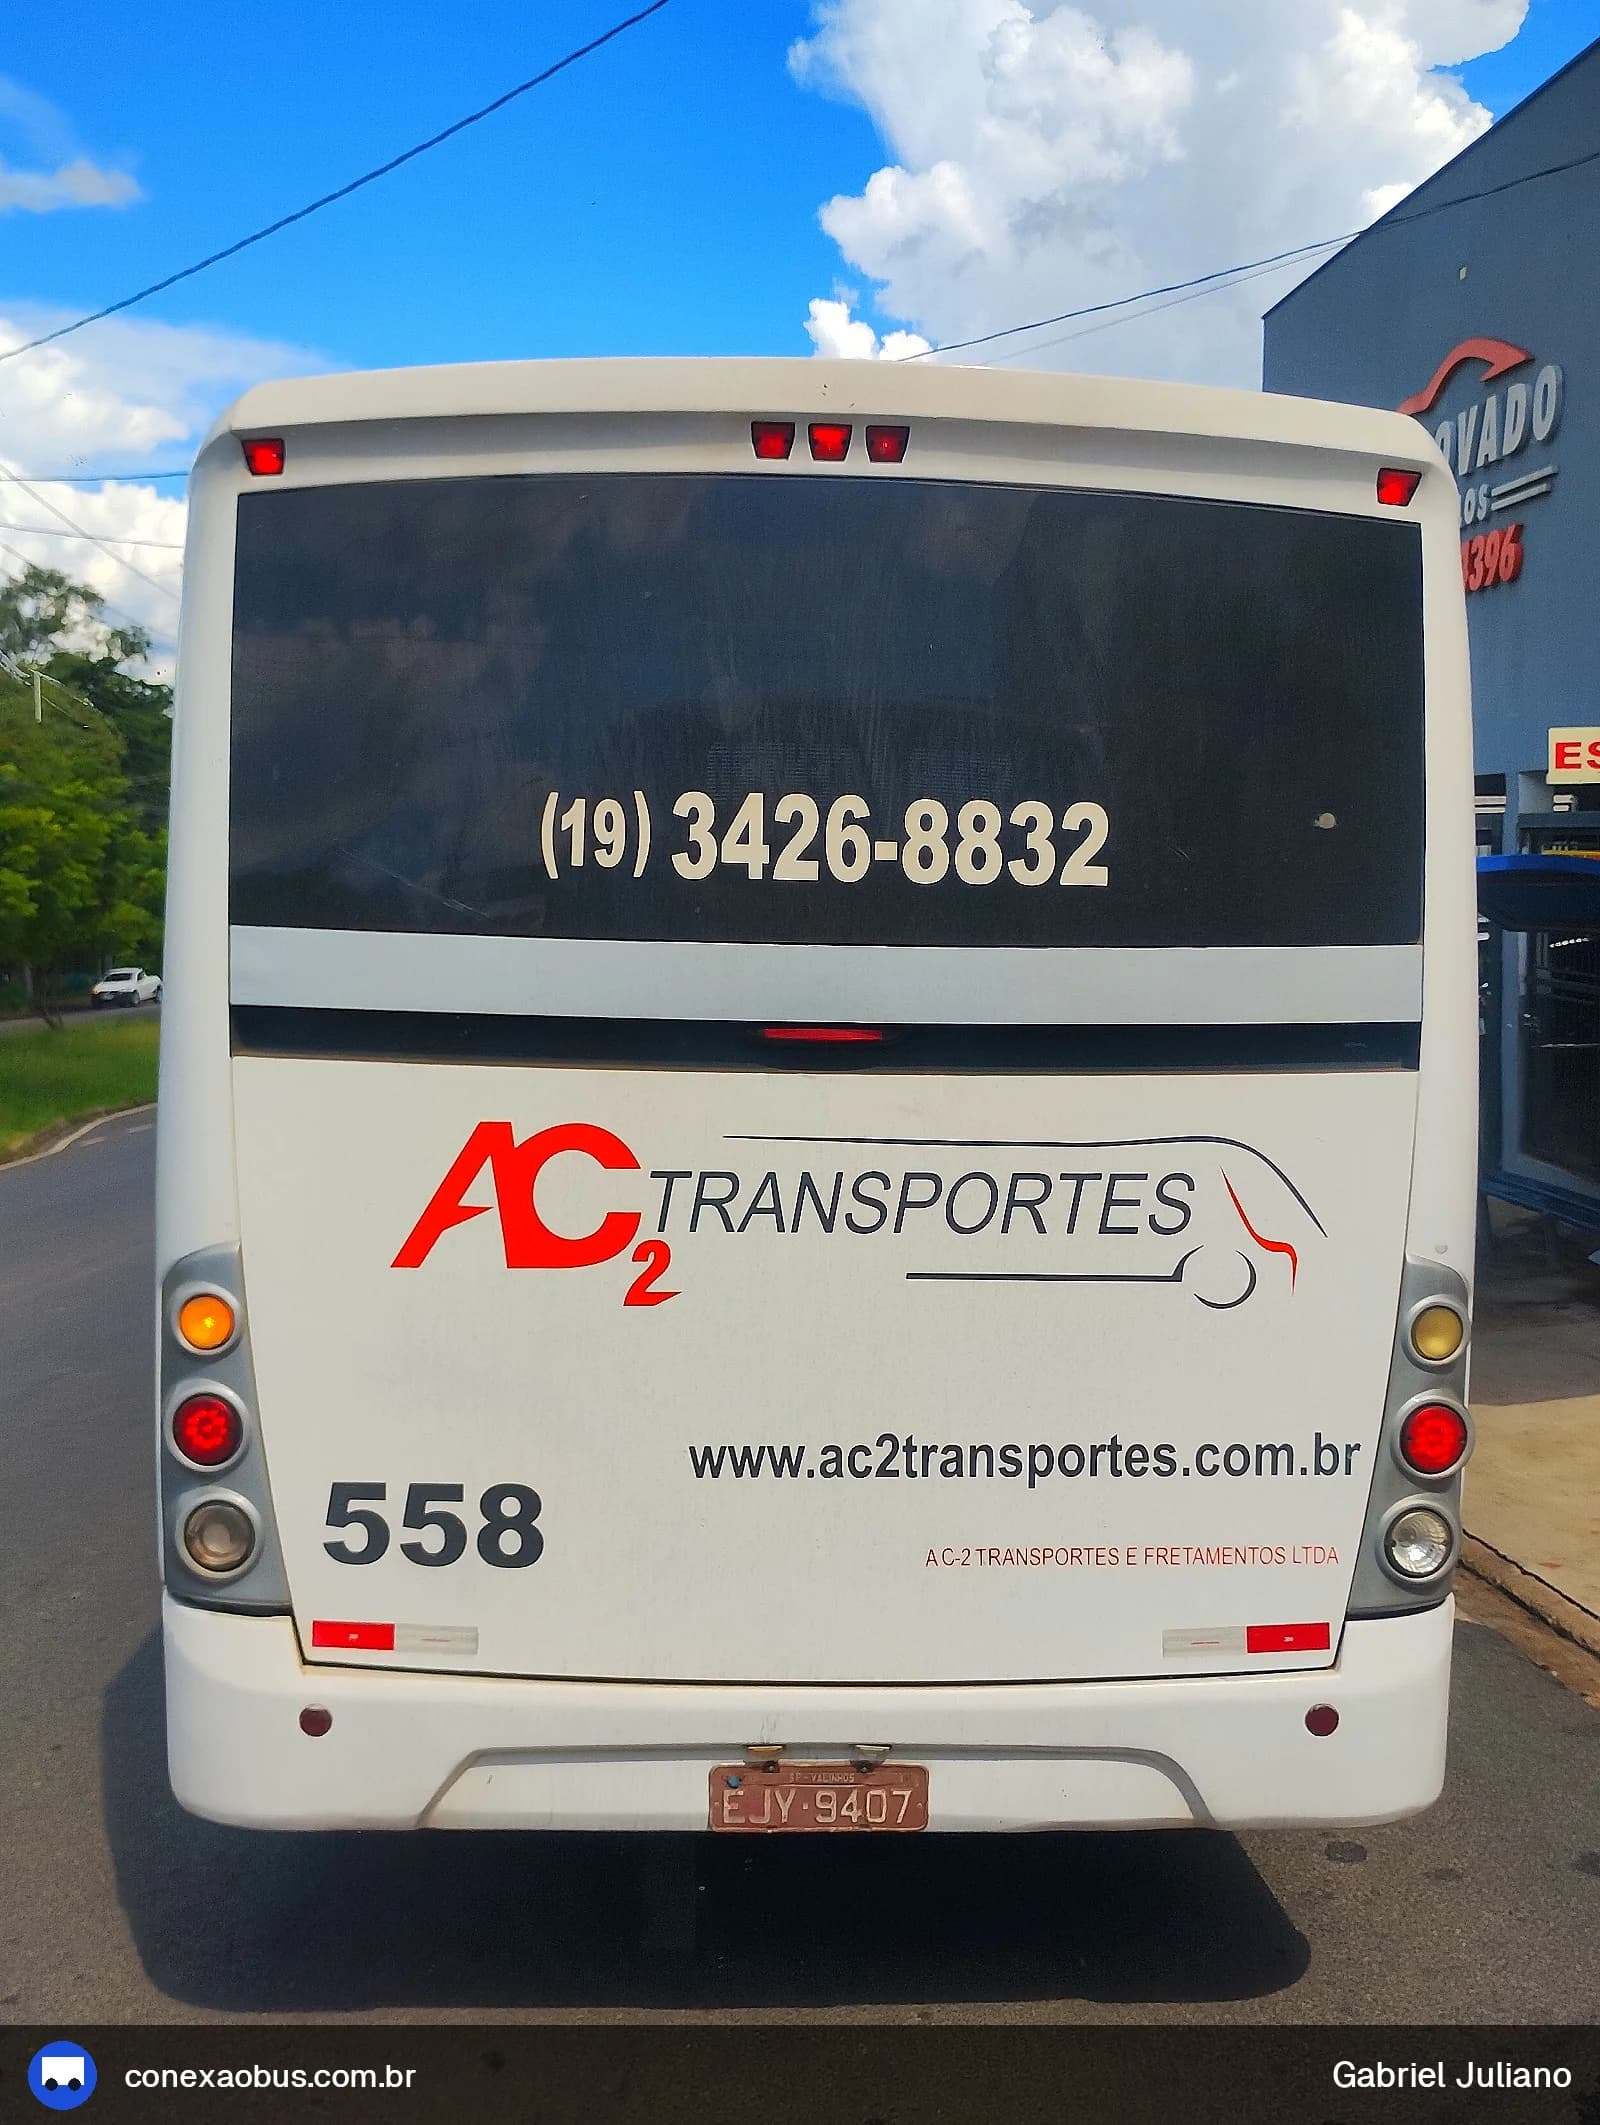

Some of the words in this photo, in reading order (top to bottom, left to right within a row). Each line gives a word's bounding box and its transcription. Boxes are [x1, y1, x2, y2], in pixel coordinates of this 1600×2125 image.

[540, 791, 651, 879] (19)
[671, 790, 1109, 887] 3426-8832
[650, 1170, 1196, 1236] TRANSPORTES
[689, 1431, 1360, 1488] www.ac2transportes.com.br
[323, 1481, 545, 1568] 558
[975, 1547, 1120, 1567] TRANSPORTES
[1126, 1547, 1138, 1566] E
[1144, 1546, 1287, 1566] FRETAMENTOS
[1292, 1546, 1340, 1565] LTDA
